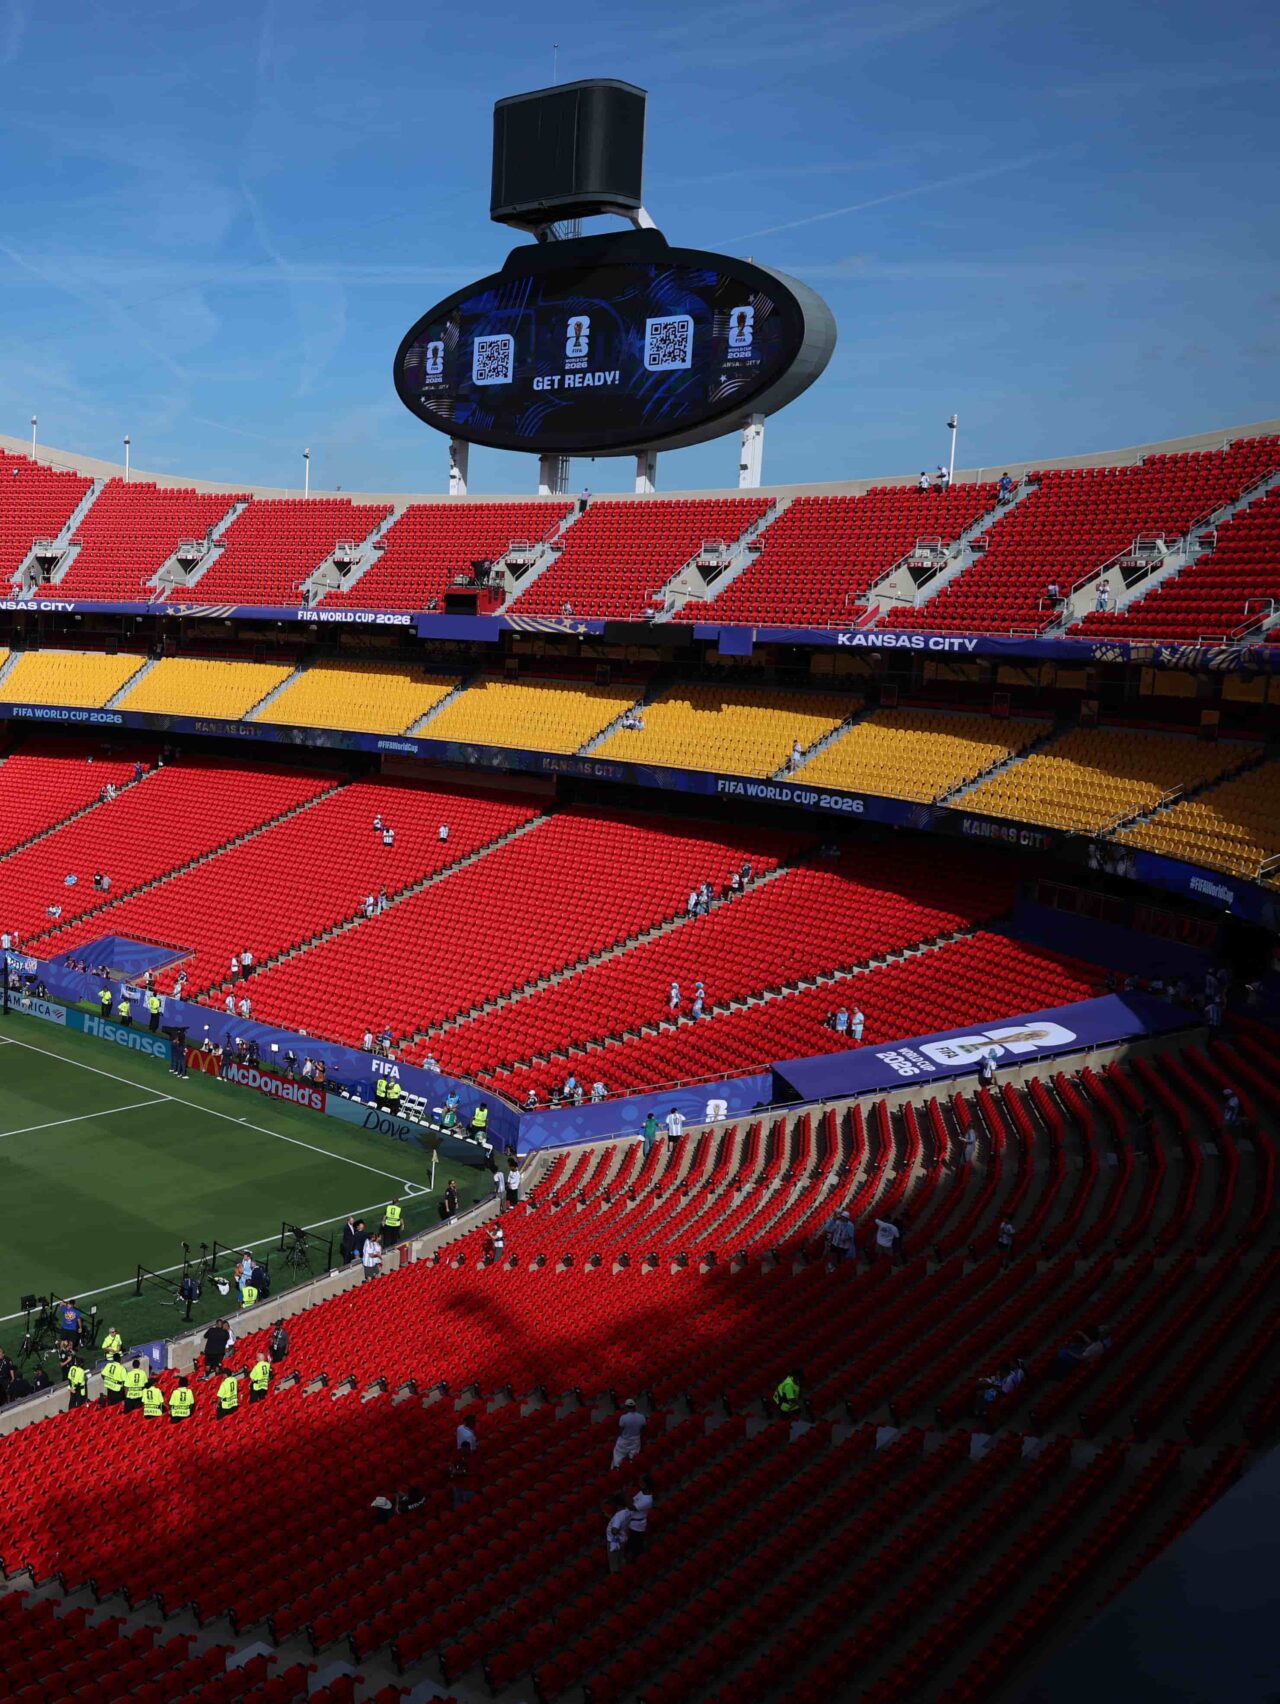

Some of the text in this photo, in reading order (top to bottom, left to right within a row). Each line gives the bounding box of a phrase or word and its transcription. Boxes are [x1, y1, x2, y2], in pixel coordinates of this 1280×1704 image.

[727, 351, 752, 359] 2026
[533, 370, 620, 390] GET READY!
[40, 602, 75, 612] CITY
[298, 611, 411, 625] FIFA WORLD CUP 2026
[837, 633, 978, 652] KANSAS CITY
[13, 708, 123, 724] FIFA WORLD CUP 2026
[377, 740, 418, 753] #FIFAWorldCup
[717, 779, 864, 812] FIFA WORLD CUP 2026
[962, 818, 1052, 849] KANSAS CITY
[1189, 876, 1235, 904] #FIFAWorldCup
[7, 994, 51, 1017] AMRICA
[83, 1014, 166, 1058] Hisense
[897, 1047, 937, 1072] WORLD CUP
[935, 1046, 958, 1059] FIFA
[371, 1059, 400, 1079] FIFA
[875, 1051, 921, 1077] 2026
[222, 1063, 322, 1110] McDonald's
[361, 1108, 411, 1142] Dove
